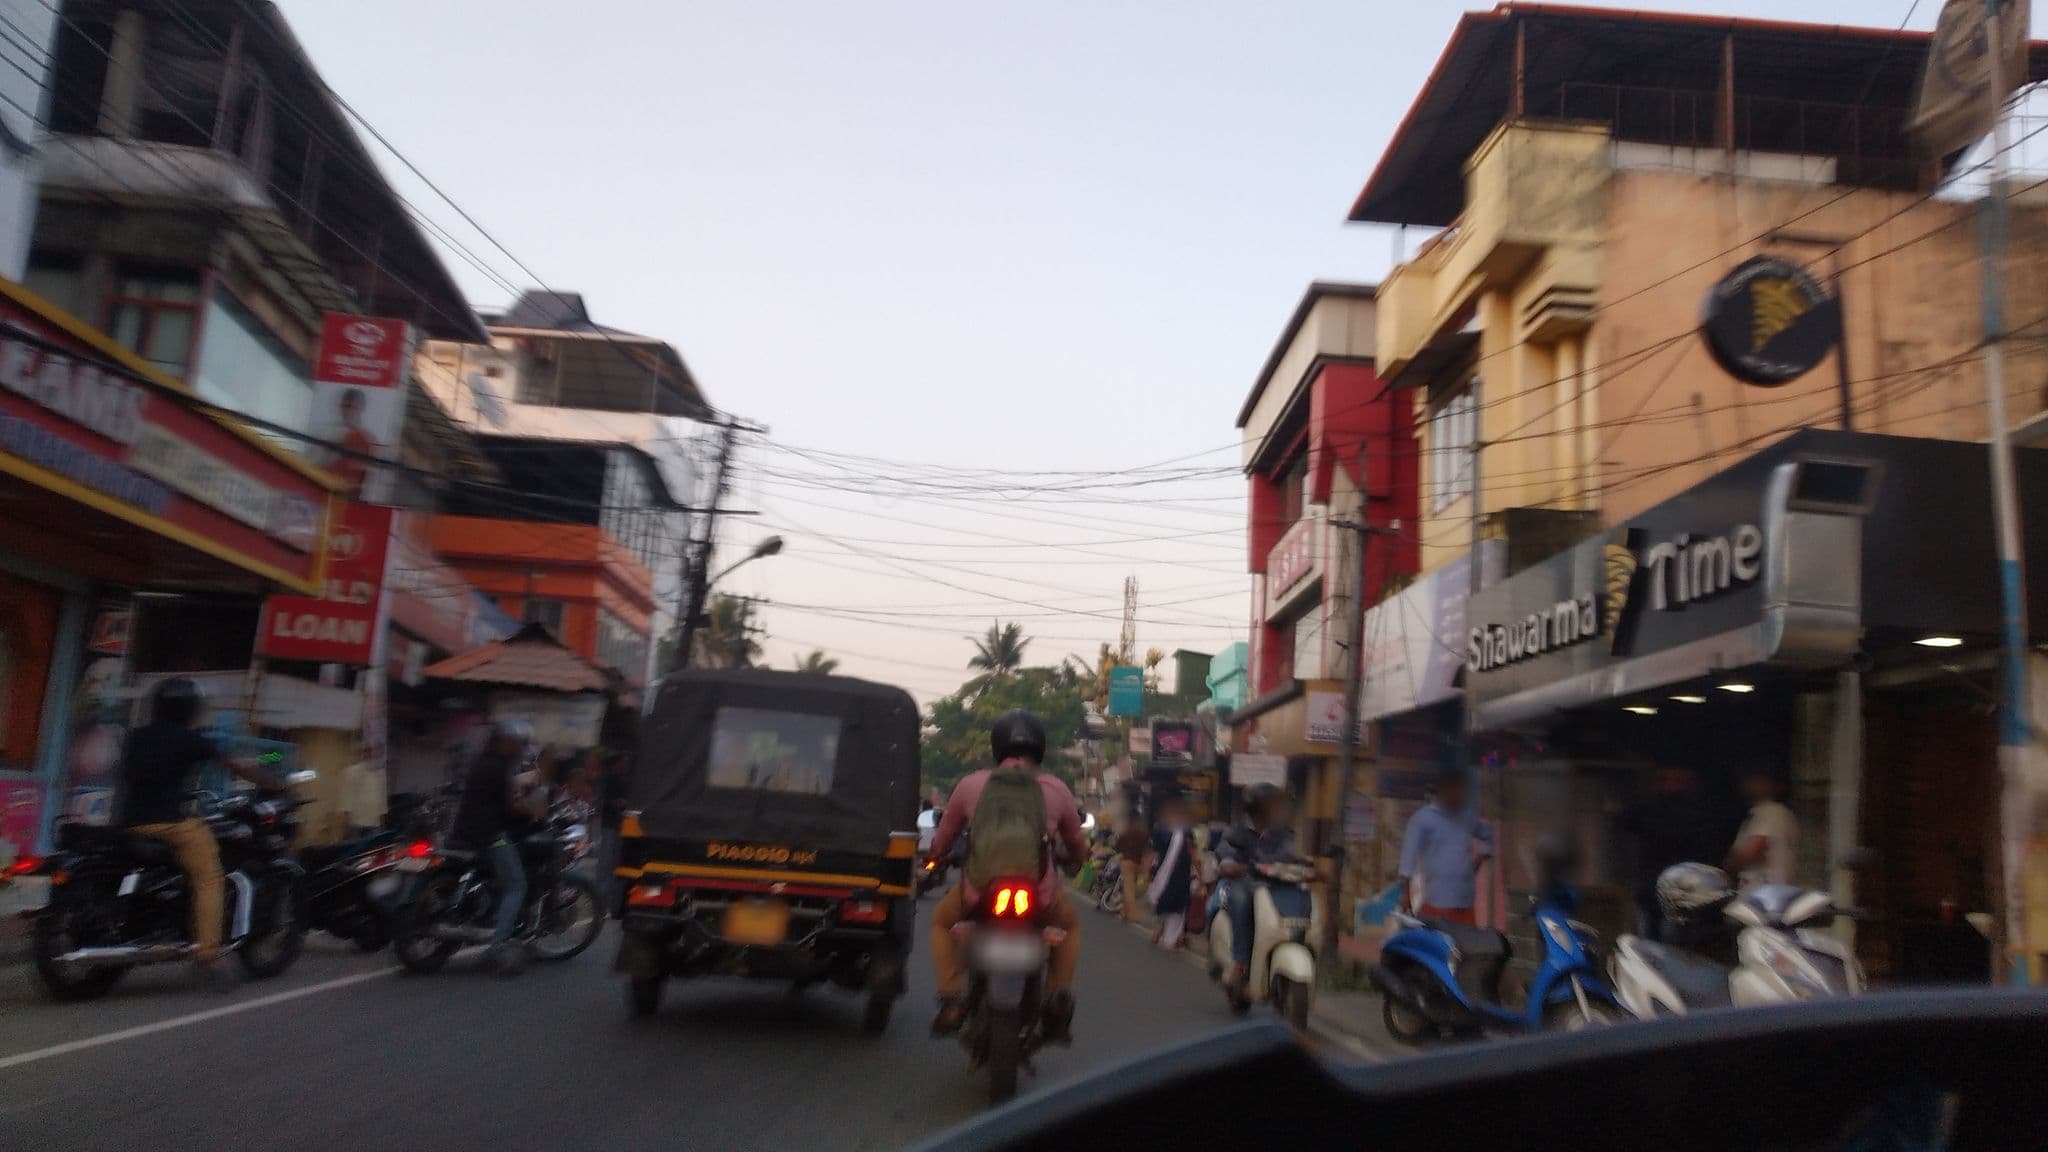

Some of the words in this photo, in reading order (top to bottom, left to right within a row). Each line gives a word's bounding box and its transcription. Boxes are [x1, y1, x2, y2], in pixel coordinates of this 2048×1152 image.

[272, 611, 369, 645] LOAN
[1466, 592, 1596, 673] Shawarma
[1646, 523, 1763, 610] Time
